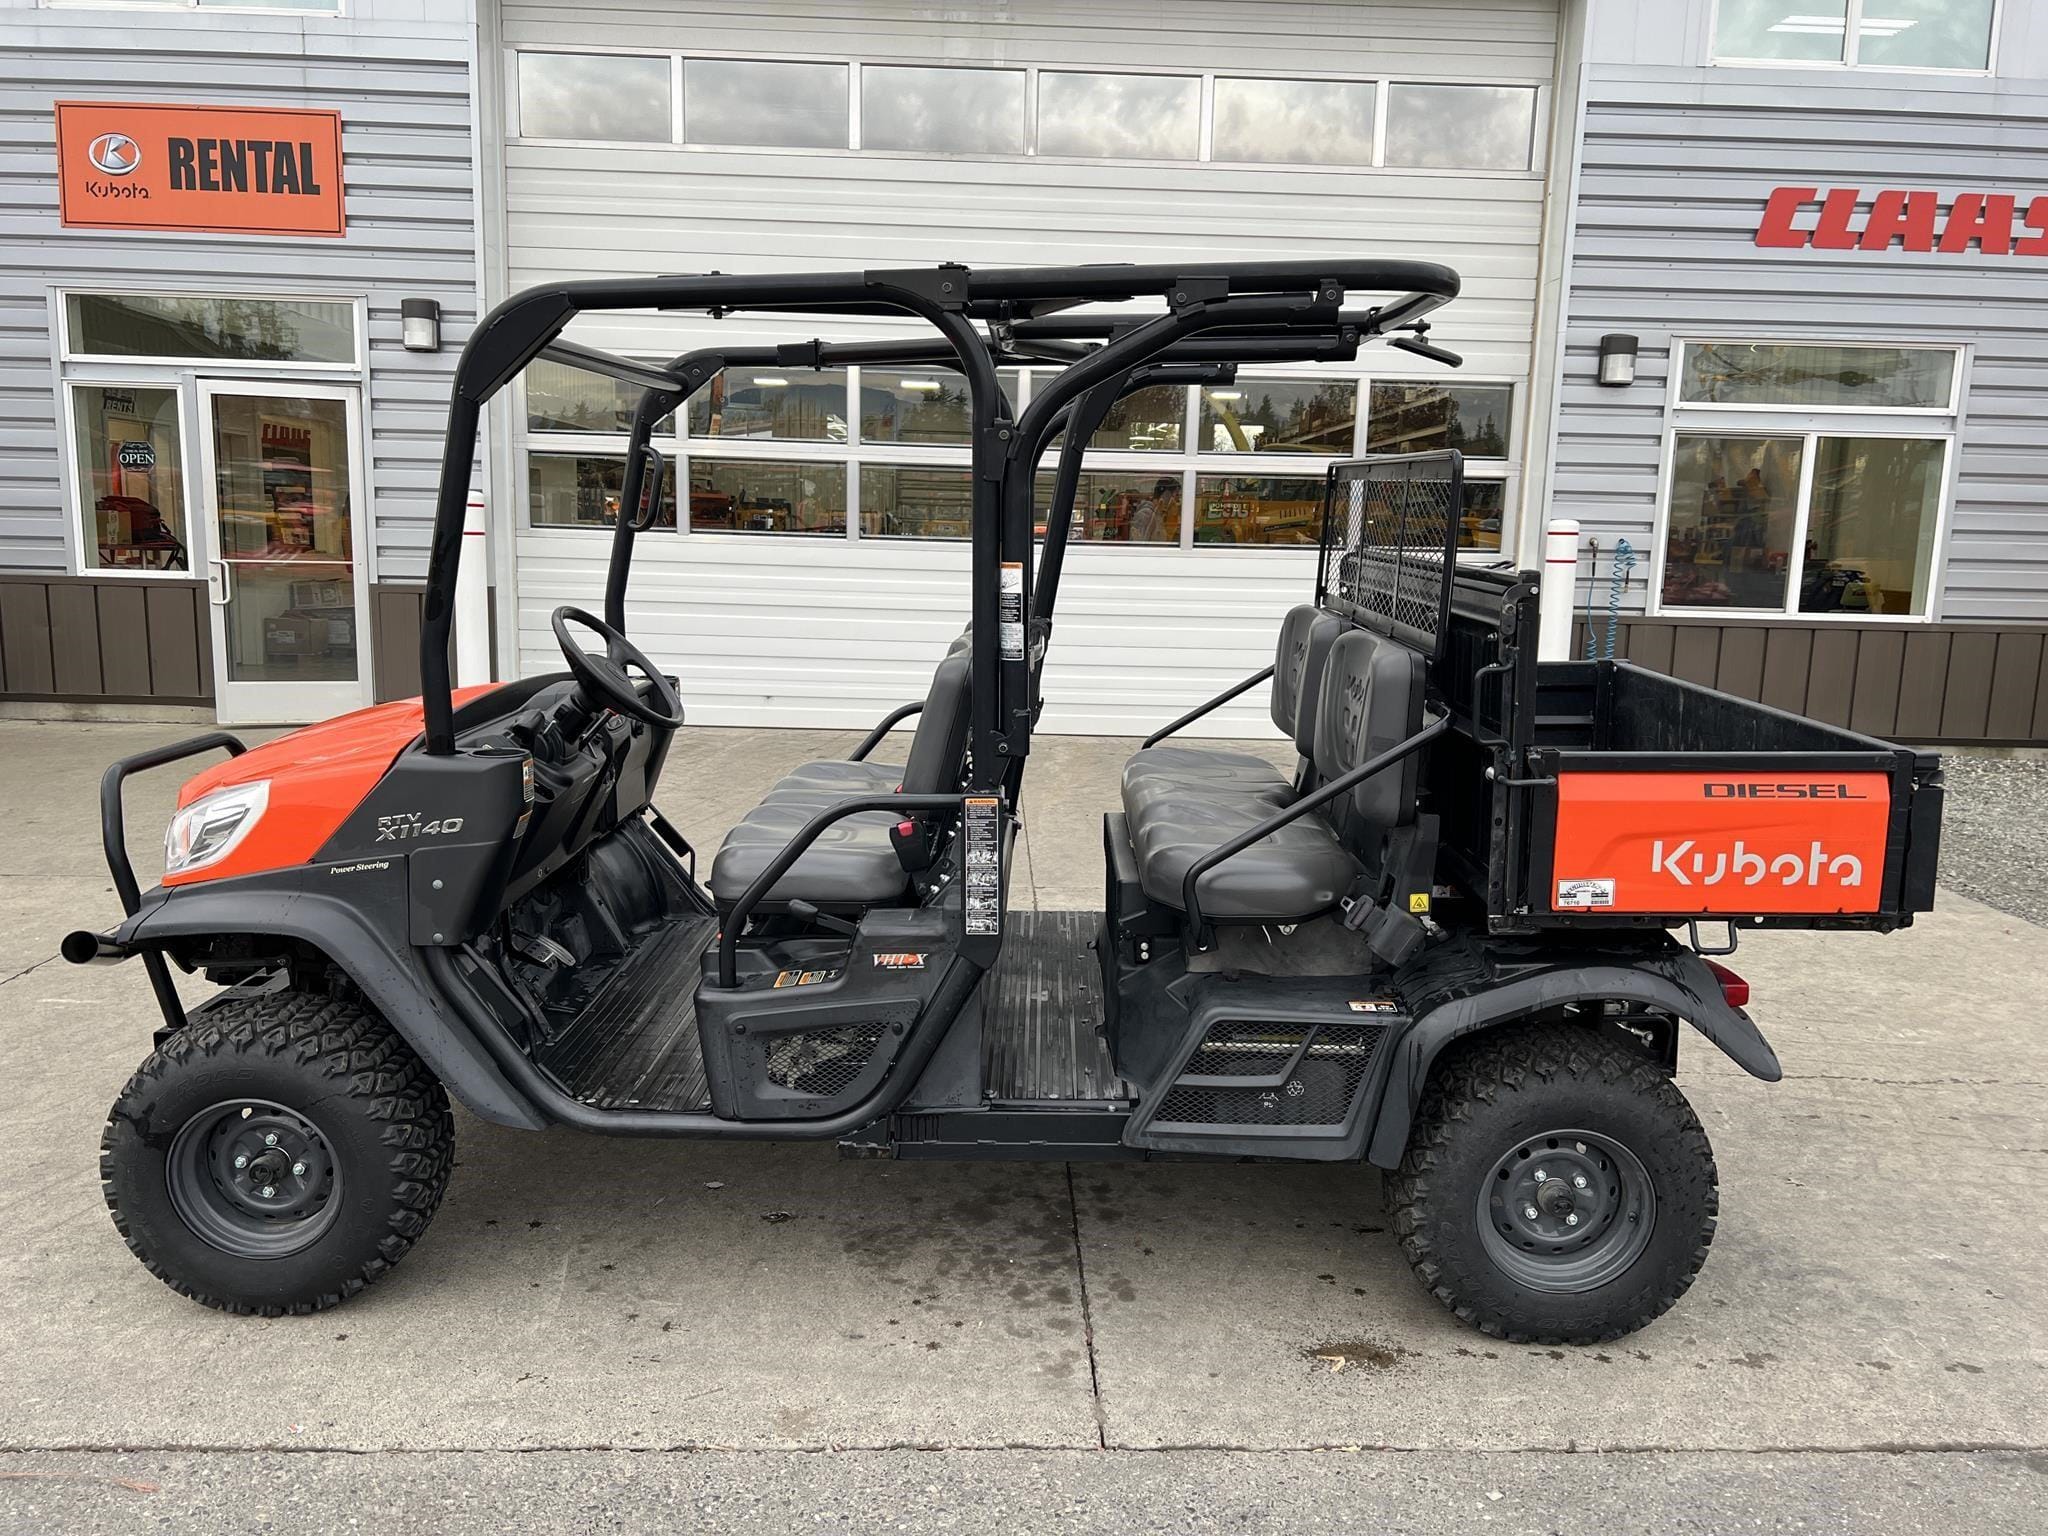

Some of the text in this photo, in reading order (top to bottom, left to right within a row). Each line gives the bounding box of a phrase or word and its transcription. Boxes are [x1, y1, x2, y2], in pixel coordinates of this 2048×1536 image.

[167, 137, 321, 196] RENTAL
[85, 181, 149, 199] Kubota
[119, 452, 155, 464] OPEN
[1703, 783, 1867, 799] DIESEL
[377, 812, 422, 827] RTV
[375, 817, 464, 842] X1140
[330, 860, 390, 875] Power Steering
[1651, 840, 1863, 887] Kubota
